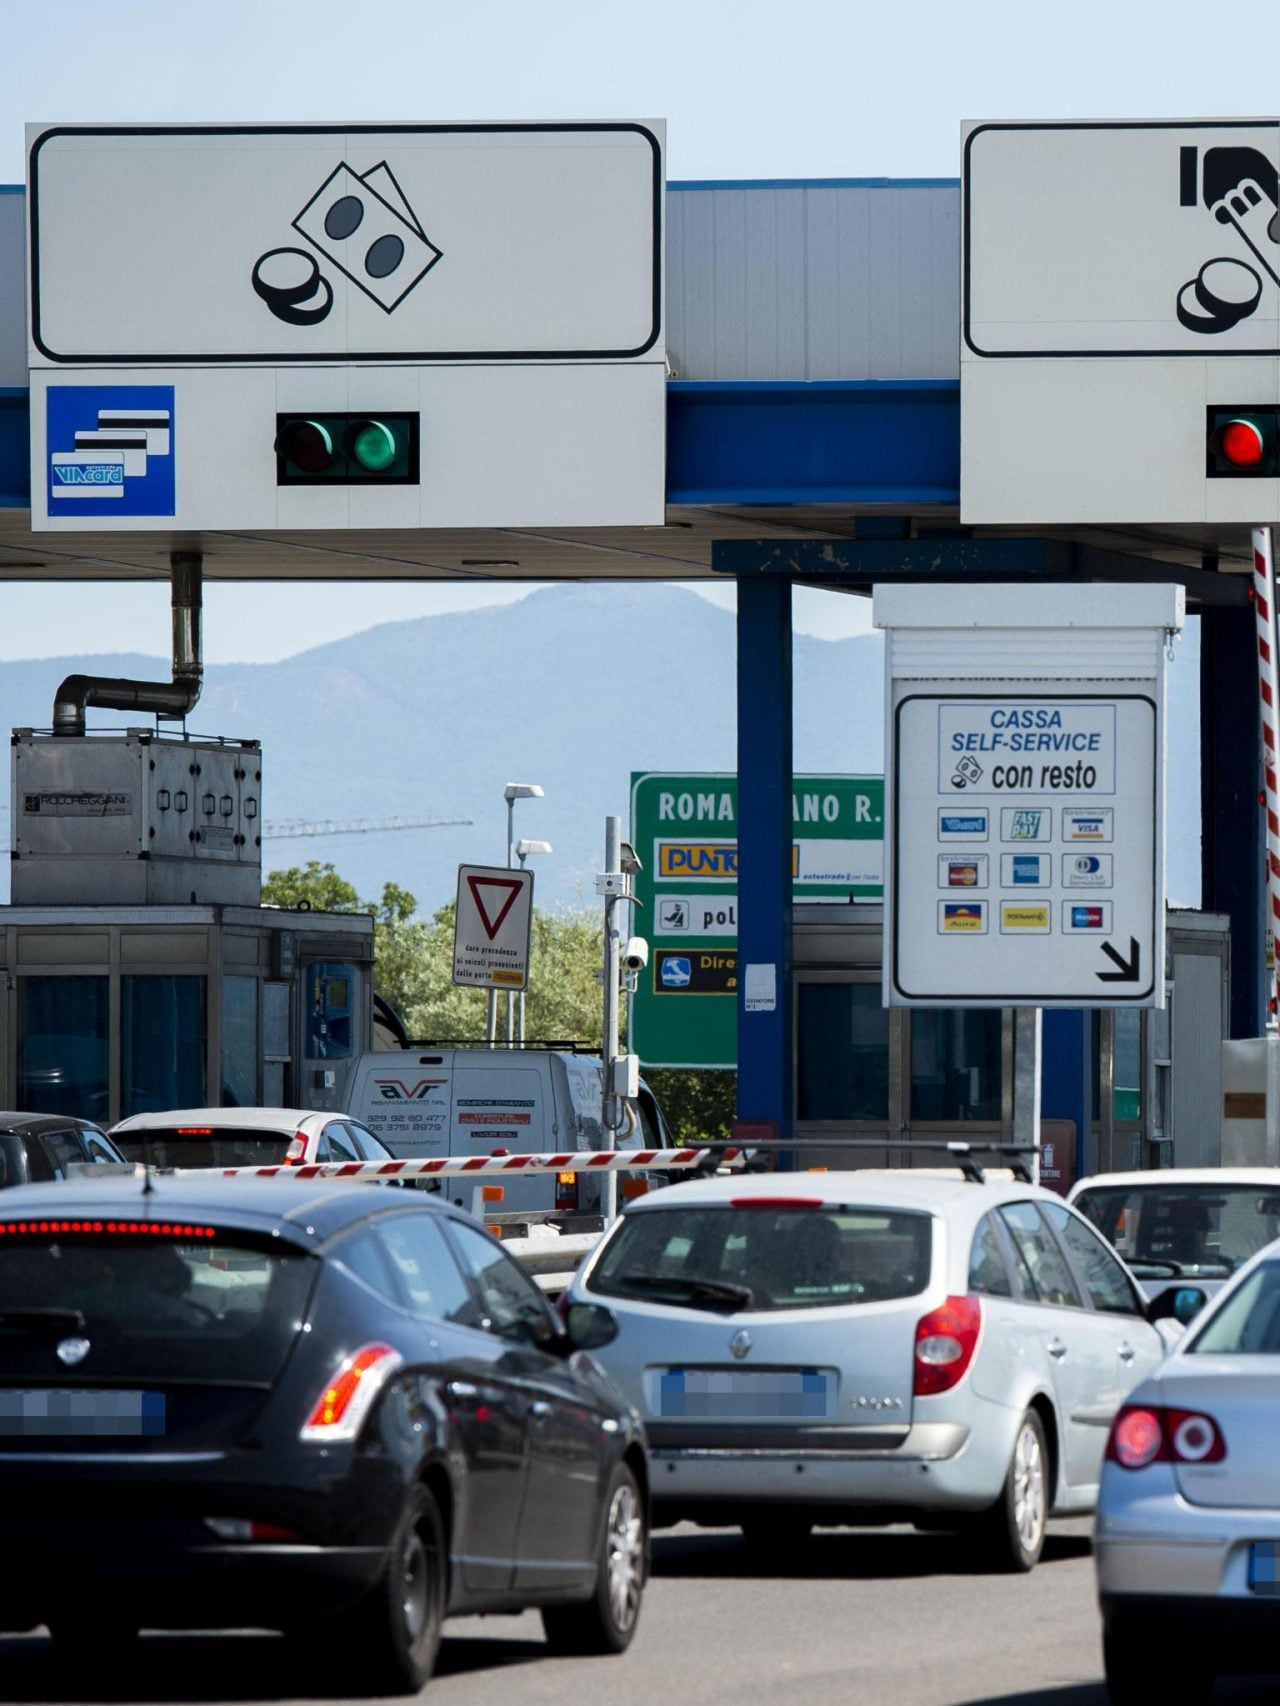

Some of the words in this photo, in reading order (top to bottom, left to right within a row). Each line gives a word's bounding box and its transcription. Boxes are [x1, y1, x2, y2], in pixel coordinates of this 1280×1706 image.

[54, 465, 123, 484] VIAcard
[990, 710, 1062, 728] CASSA
[951, 733, 1101, 751] SELF-SERVICE
[992, 764, 1033, 789] con
[1040, 760, 1097, 789] resto
[659, 792, 735, 821] ROMA
[855, 794, 882, 822] R.
[1014, 811, 1041, 825] FAST
[1077, 824, 1100, 833] VISA
[703, 909, 736, 929] pol
[465, 944, 480, 953] dare
[465, 958, 486, 966] veicoli
[488, 960, 524, 970] provenienti
[391, 1114, 405, 1122] 92
[426, 1114, 447, 1122] 477
[369, 1123, 384, 1131] 06
[387, 1123, 409, 1131] 3751
[412, 1123, 442, 1131] 8979
